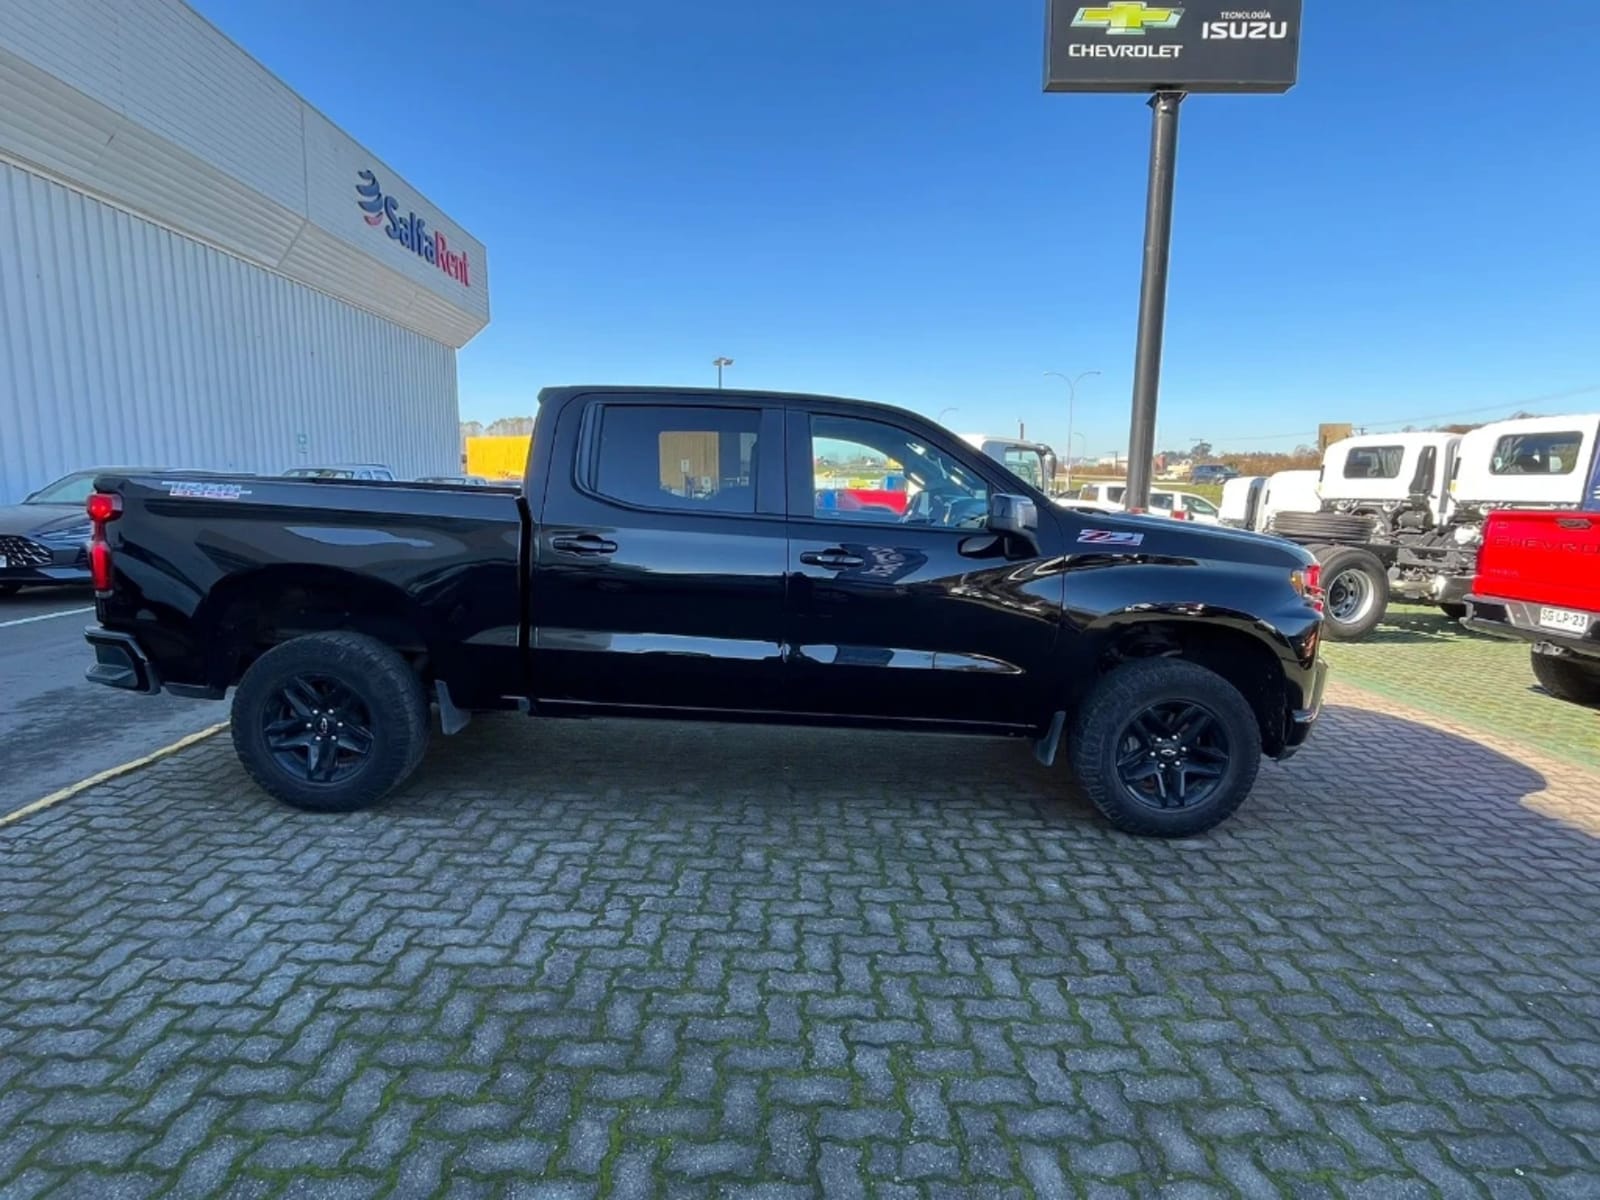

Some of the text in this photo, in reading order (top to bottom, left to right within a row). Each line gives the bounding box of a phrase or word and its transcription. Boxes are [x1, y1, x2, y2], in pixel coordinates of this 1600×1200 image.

[1219, 10, 1271, 20] TECNOLOGÍA
[1201, 21, 1288, 40] ISUZU
[1068, 43, 1184, 58] CHEVROLET
